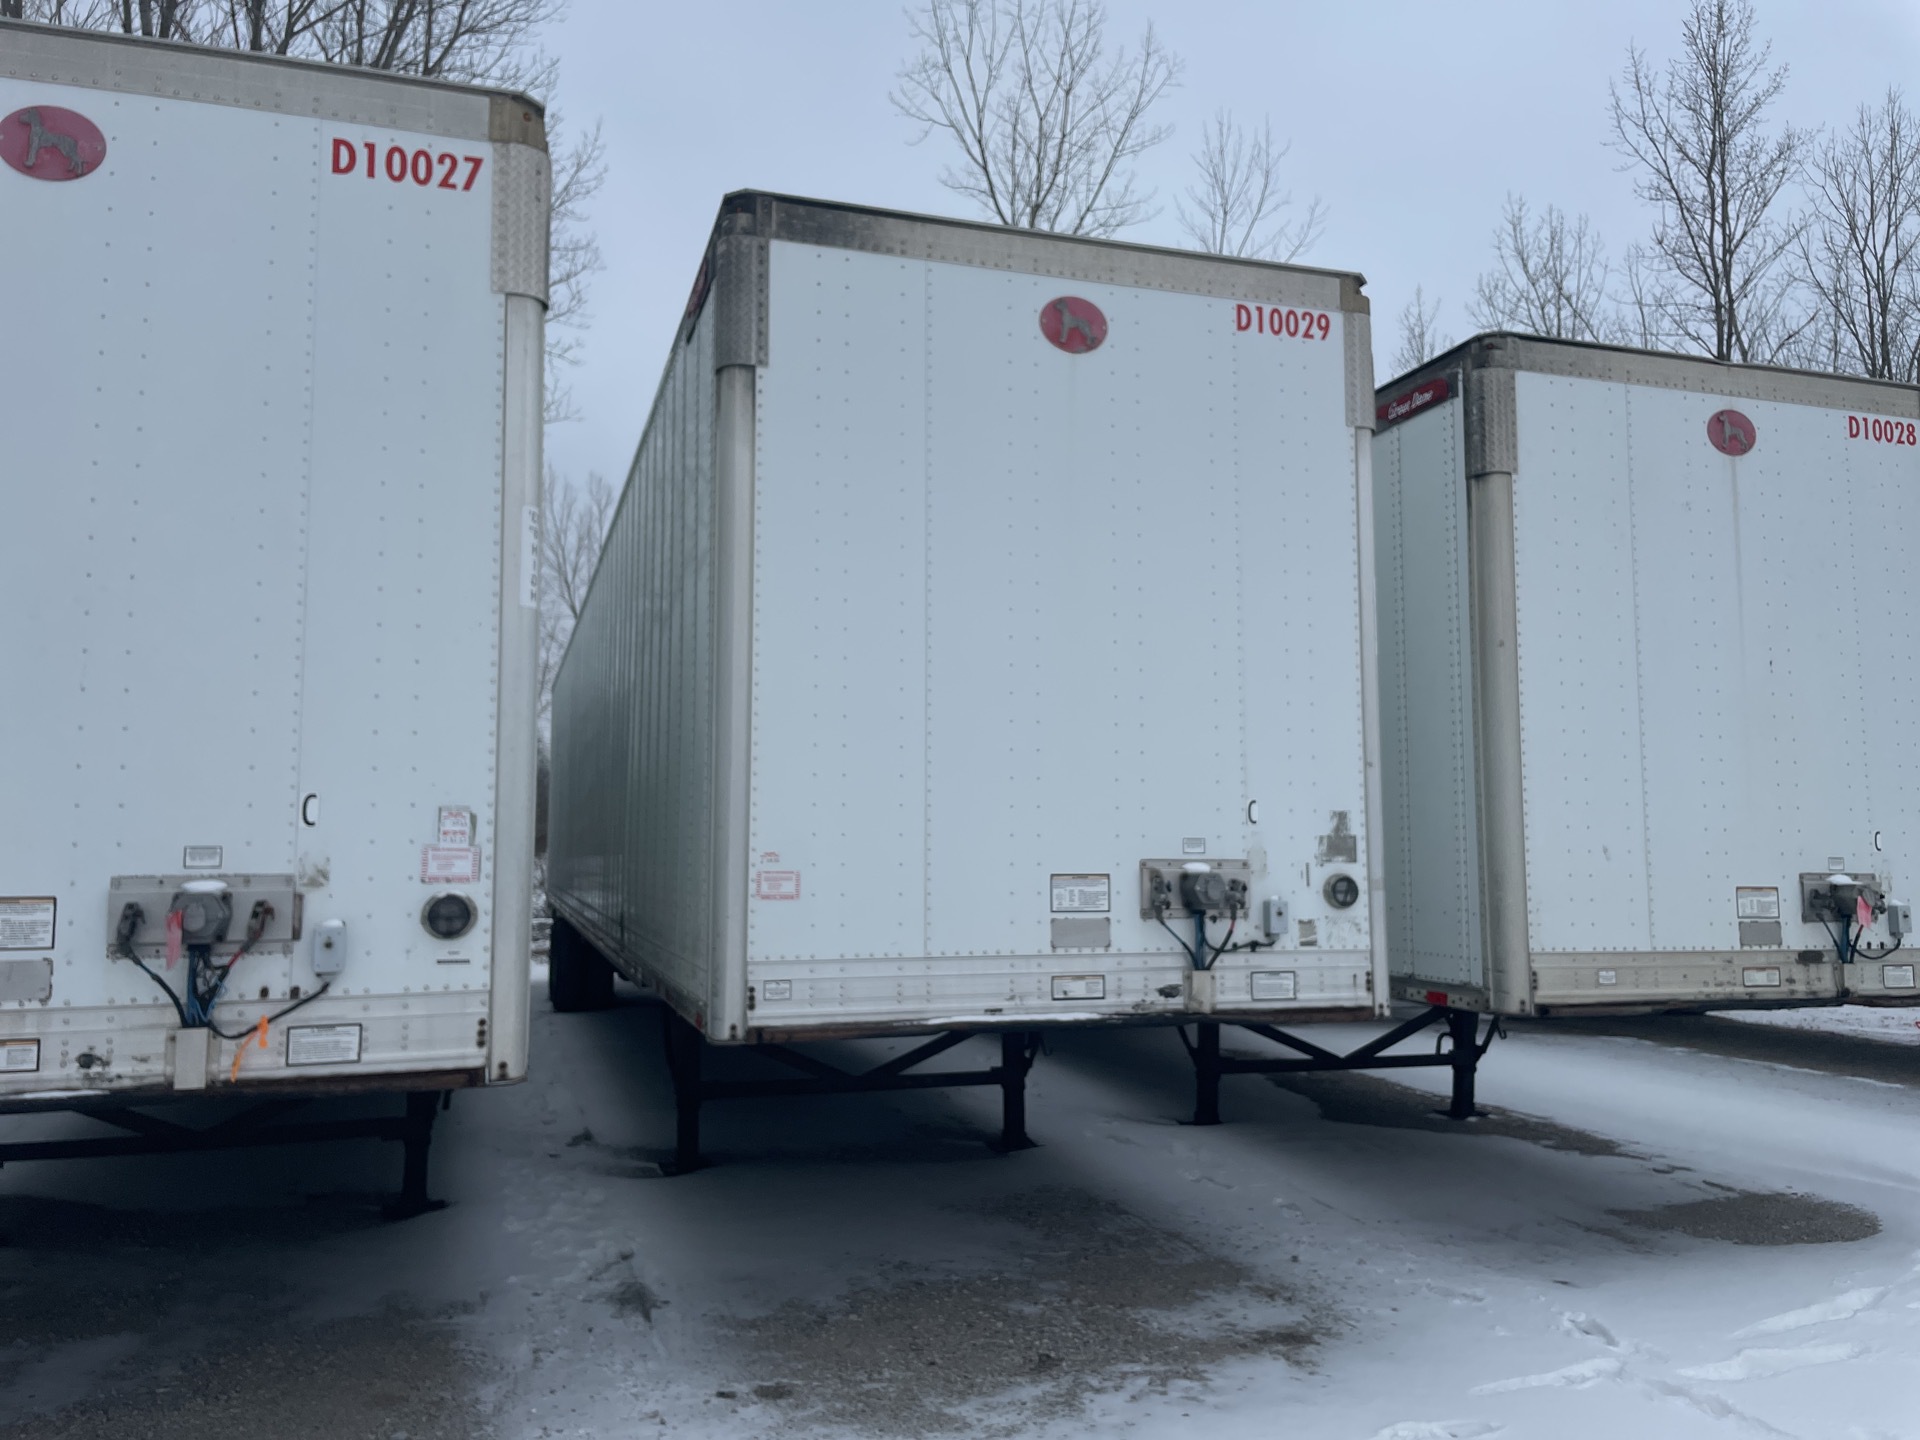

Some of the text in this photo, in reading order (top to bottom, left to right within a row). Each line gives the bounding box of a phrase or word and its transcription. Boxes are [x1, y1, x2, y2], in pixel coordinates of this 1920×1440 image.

[331, 138, 483, 191] D10027
[1236, 302, 1330, 340] D10029
[1848, 415, 1917, 446] D10028
